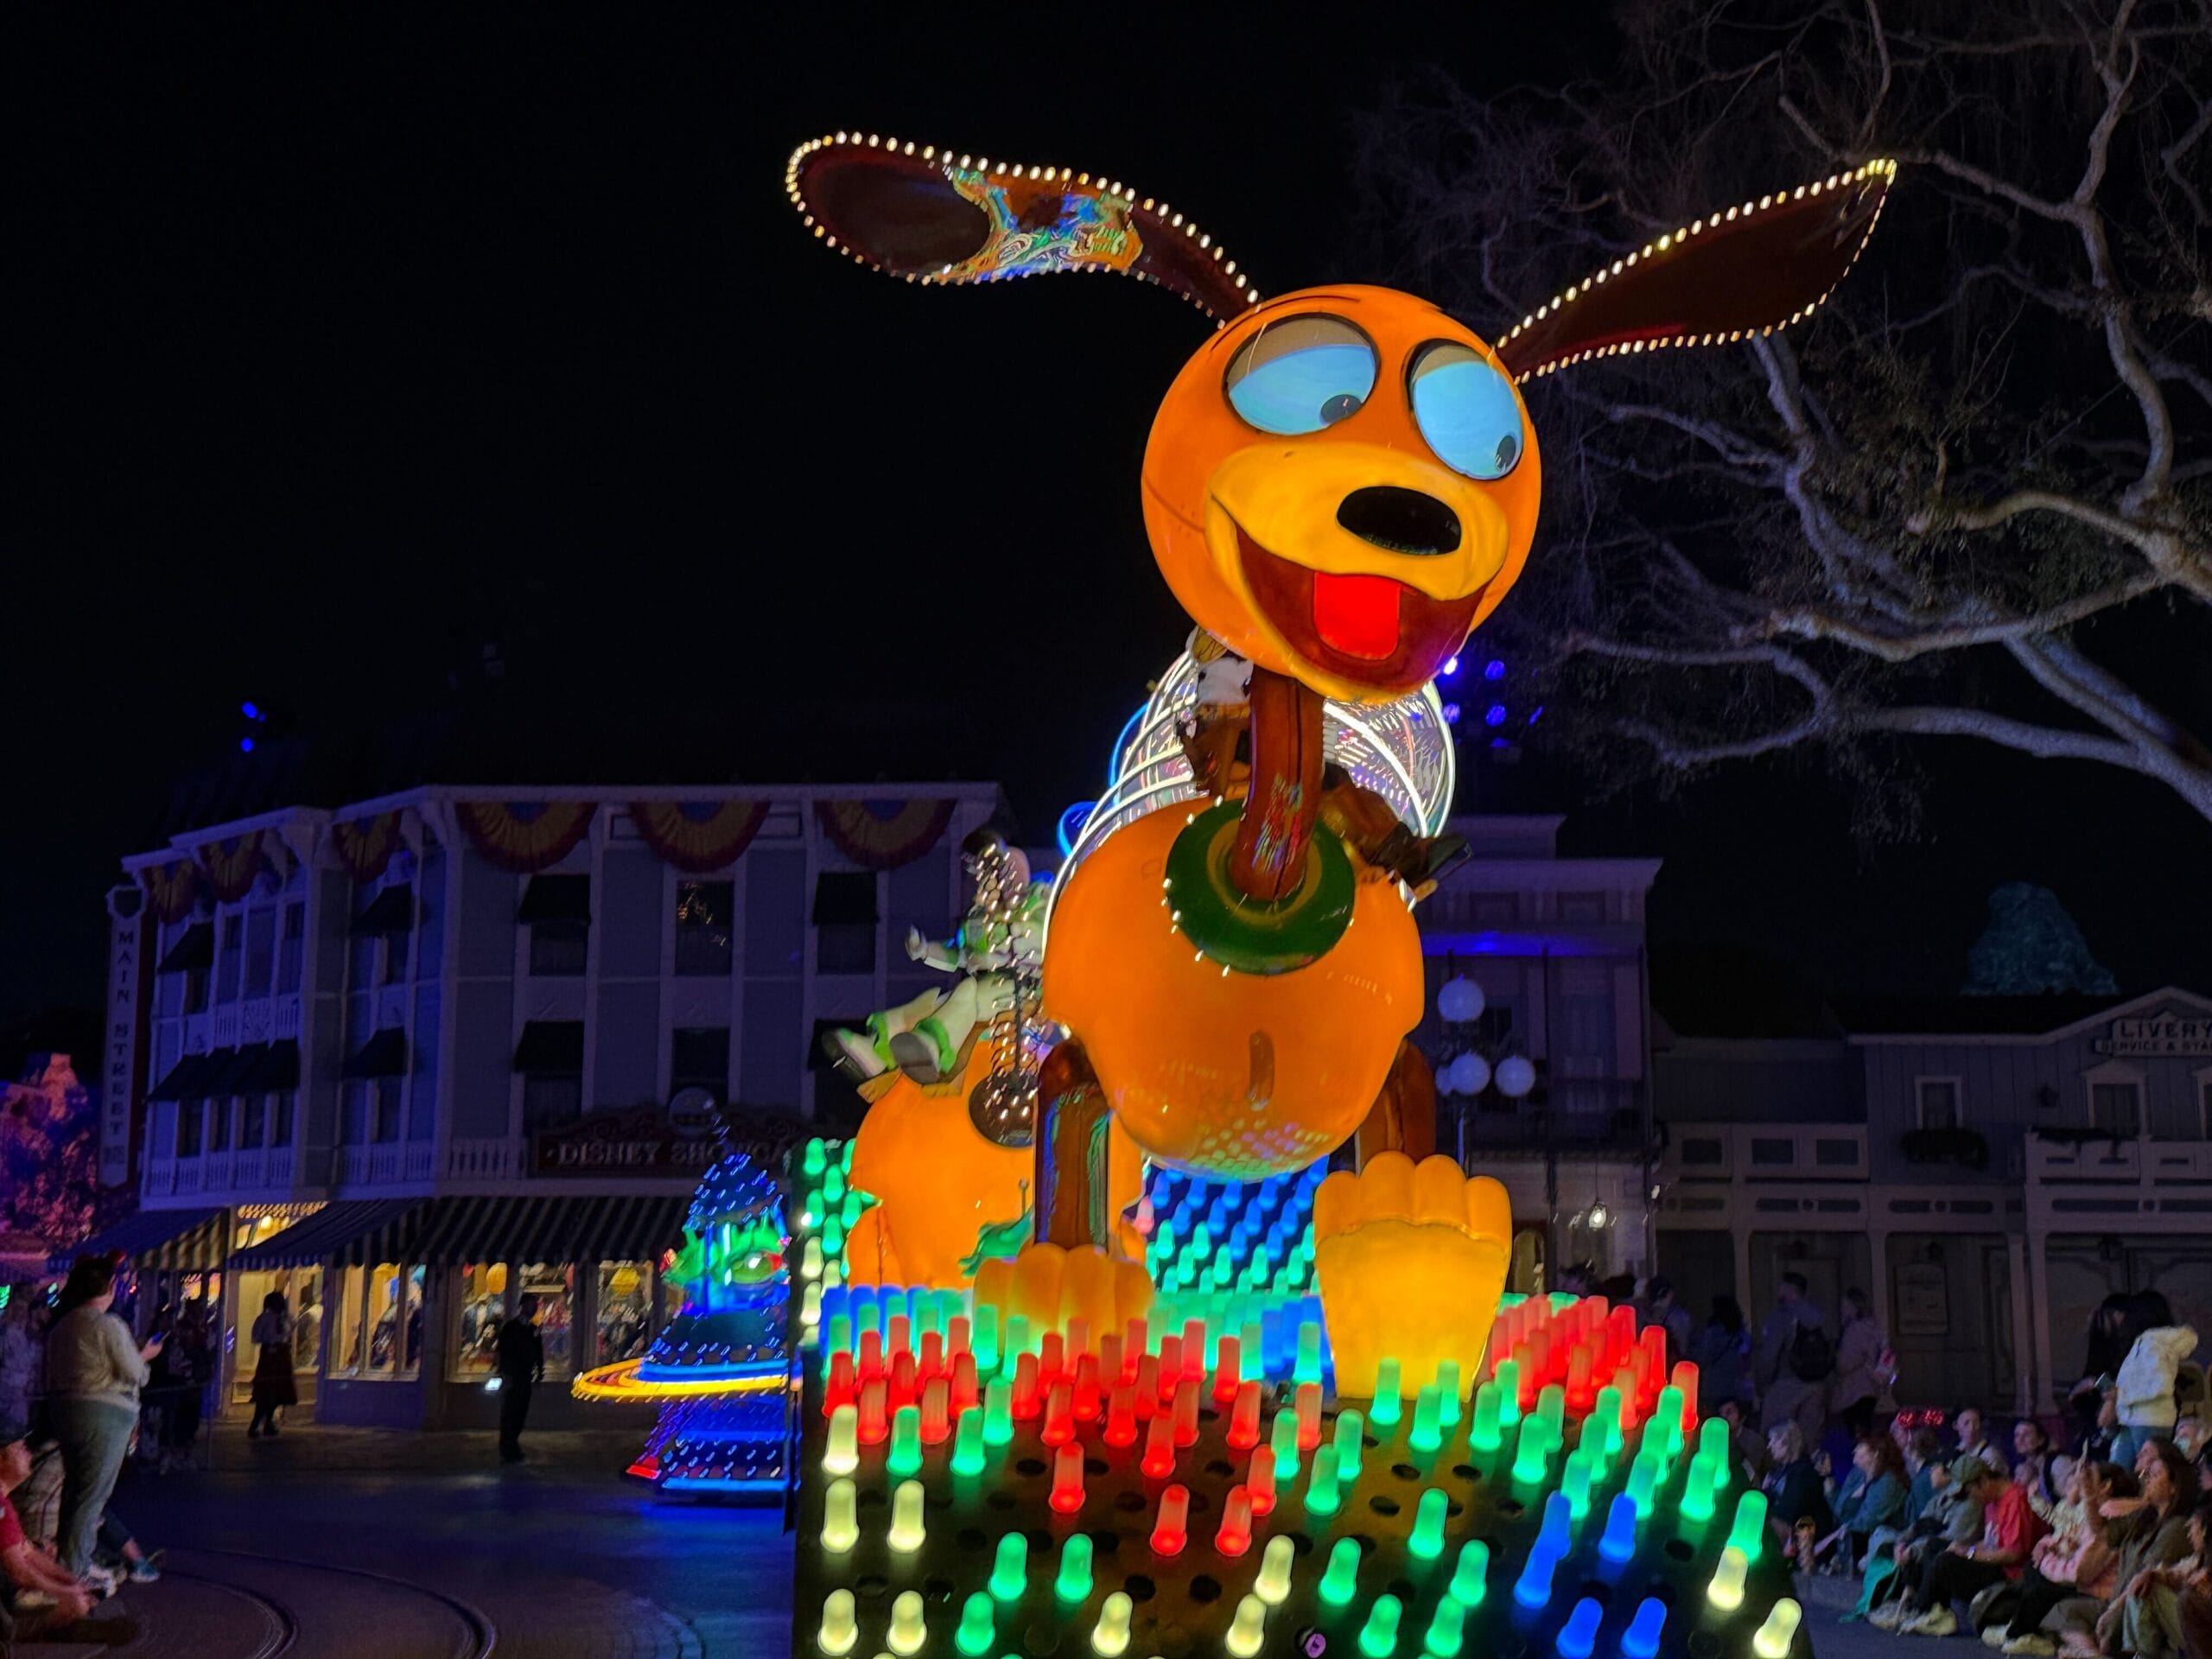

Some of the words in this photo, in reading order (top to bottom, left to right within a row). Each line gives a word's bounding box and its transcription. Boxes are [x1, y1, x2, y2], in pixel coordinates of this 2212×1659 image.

[118, 931, 135, 1003] MAIN
[111, 1024, 129, 1135] STREET
[557, 1141, 664, 1166] DISNEY
